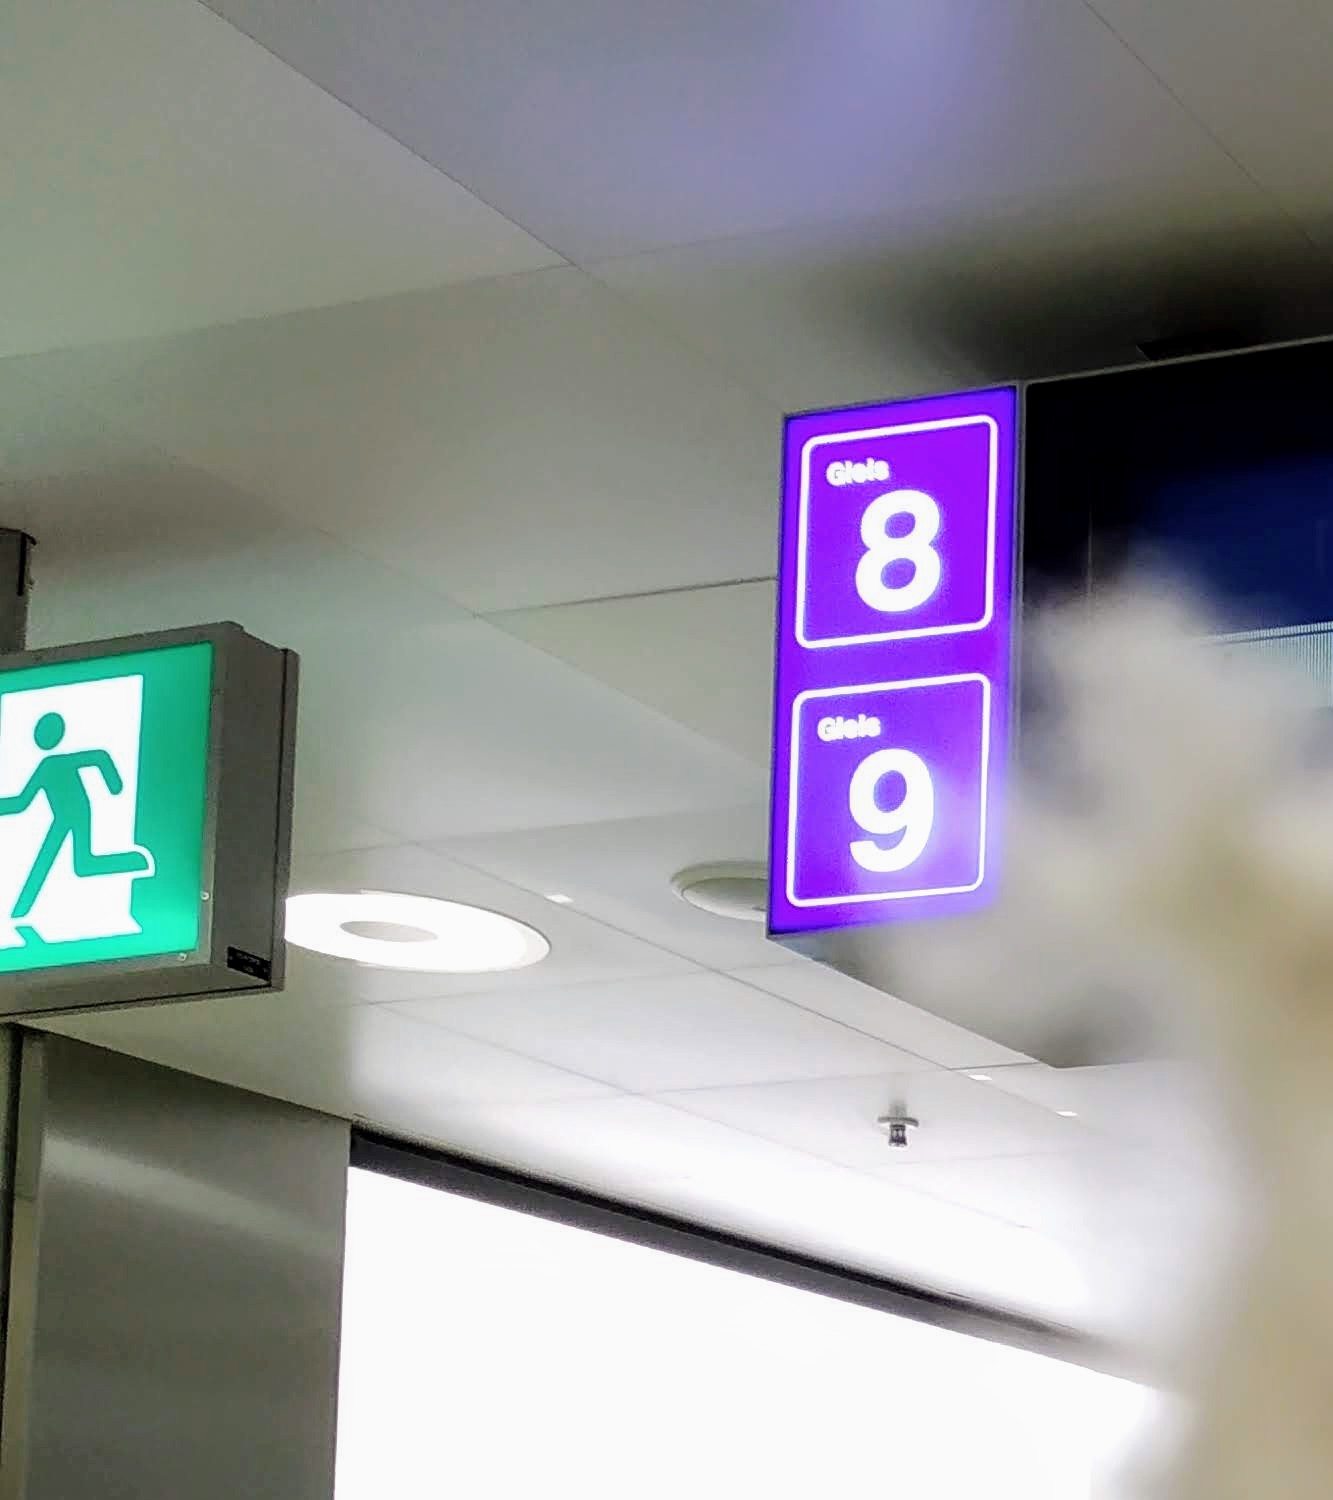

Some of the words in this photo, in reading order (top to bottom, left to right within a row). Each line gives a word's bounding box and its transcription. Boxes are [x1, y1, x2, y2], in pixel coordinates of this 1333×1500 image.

[826, 458, 890, 486] Gleis
[855, 489, 941, 612] 8
[817, 714, 882, 742] Gleis
[849, 748, 934, 872] 9
